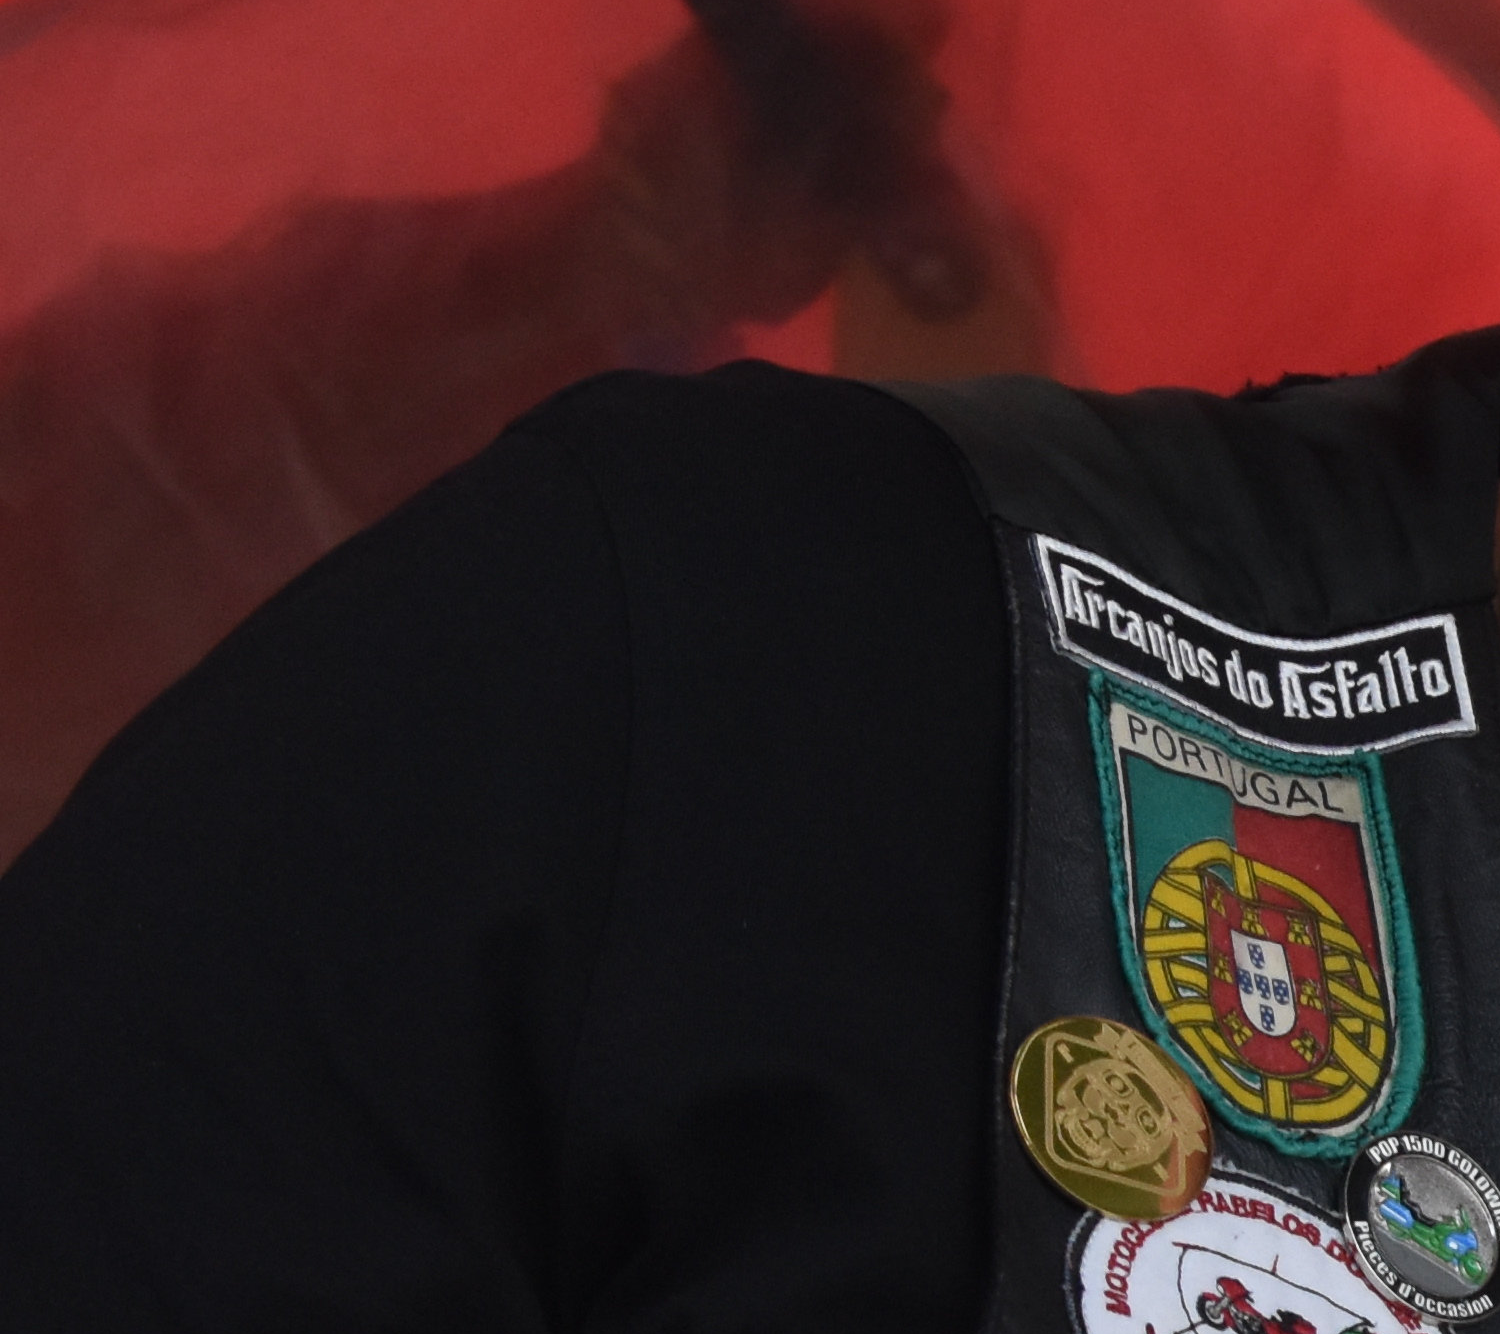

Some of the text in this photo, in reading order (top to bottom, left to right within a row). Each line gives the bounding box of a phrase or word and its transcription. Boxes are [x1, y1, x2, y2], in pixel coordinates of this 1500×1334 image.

[1060, 563, 1452, 719] Arcanjos do Asfalto
[1126, 713, 1345, 814] PORTUGAL
[1368, 1135, 1400, 1164] POP
[1401, 1134, 1446, 1159] 1500
[1104, 1206, 1193, 1317] MOTOCL
[1197, 1189, 1322, 1246] RABELOS
